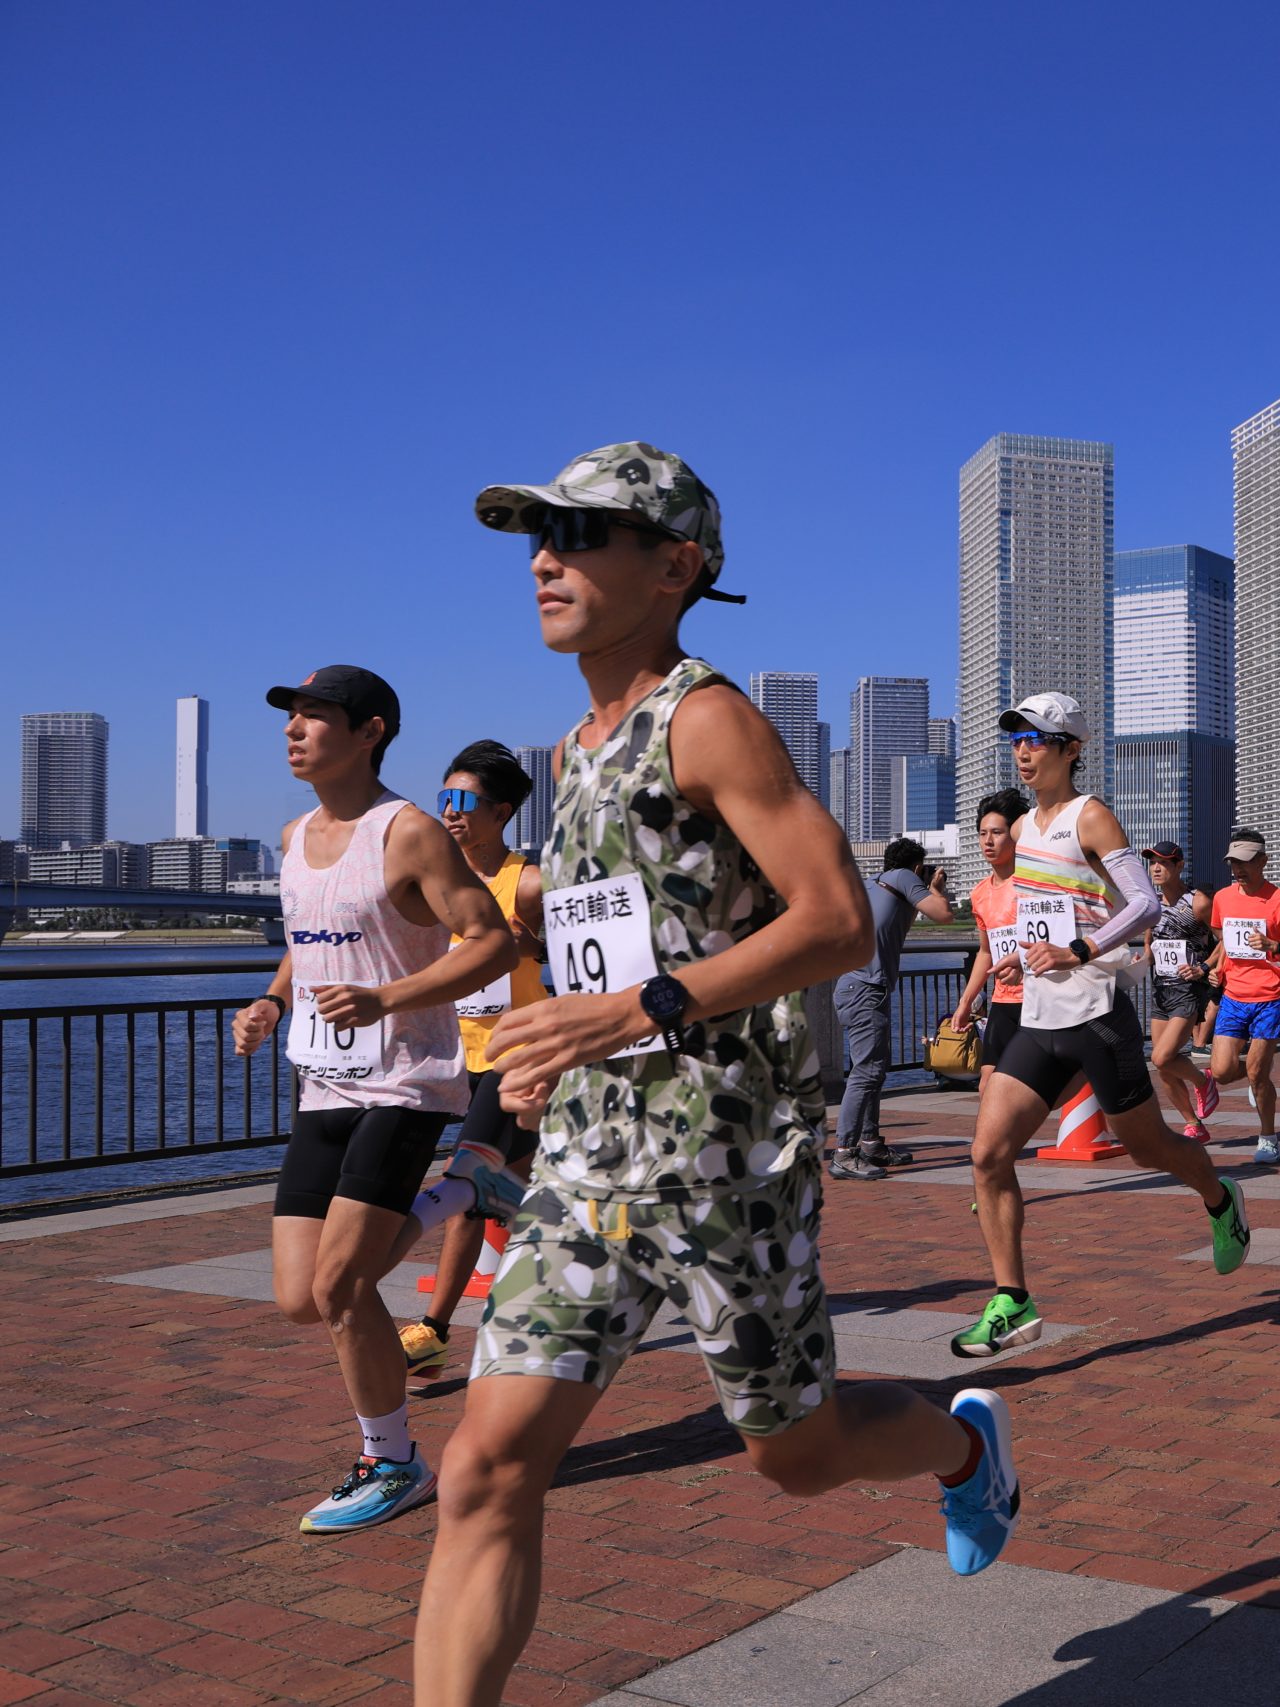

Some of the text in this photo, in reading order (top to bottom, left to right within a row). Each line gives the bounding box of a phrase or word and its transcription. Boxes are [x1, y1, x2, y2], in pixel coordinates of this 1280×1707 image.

[1049, 830, 1072, 842] HOKA
[550, 886, 634, 930] 大和輸送
[1024, 899, 1066, 916] 大和輸送
[290, 929, 362, 946] Tokyo
[1026, 920, 1050, 944] 69
[1236, 930, 1252, 947] 19
[995, 939, 1017, 960] 192
[567, 937, 608, 996] 49
[1158, 951, 1178, 966] 149
